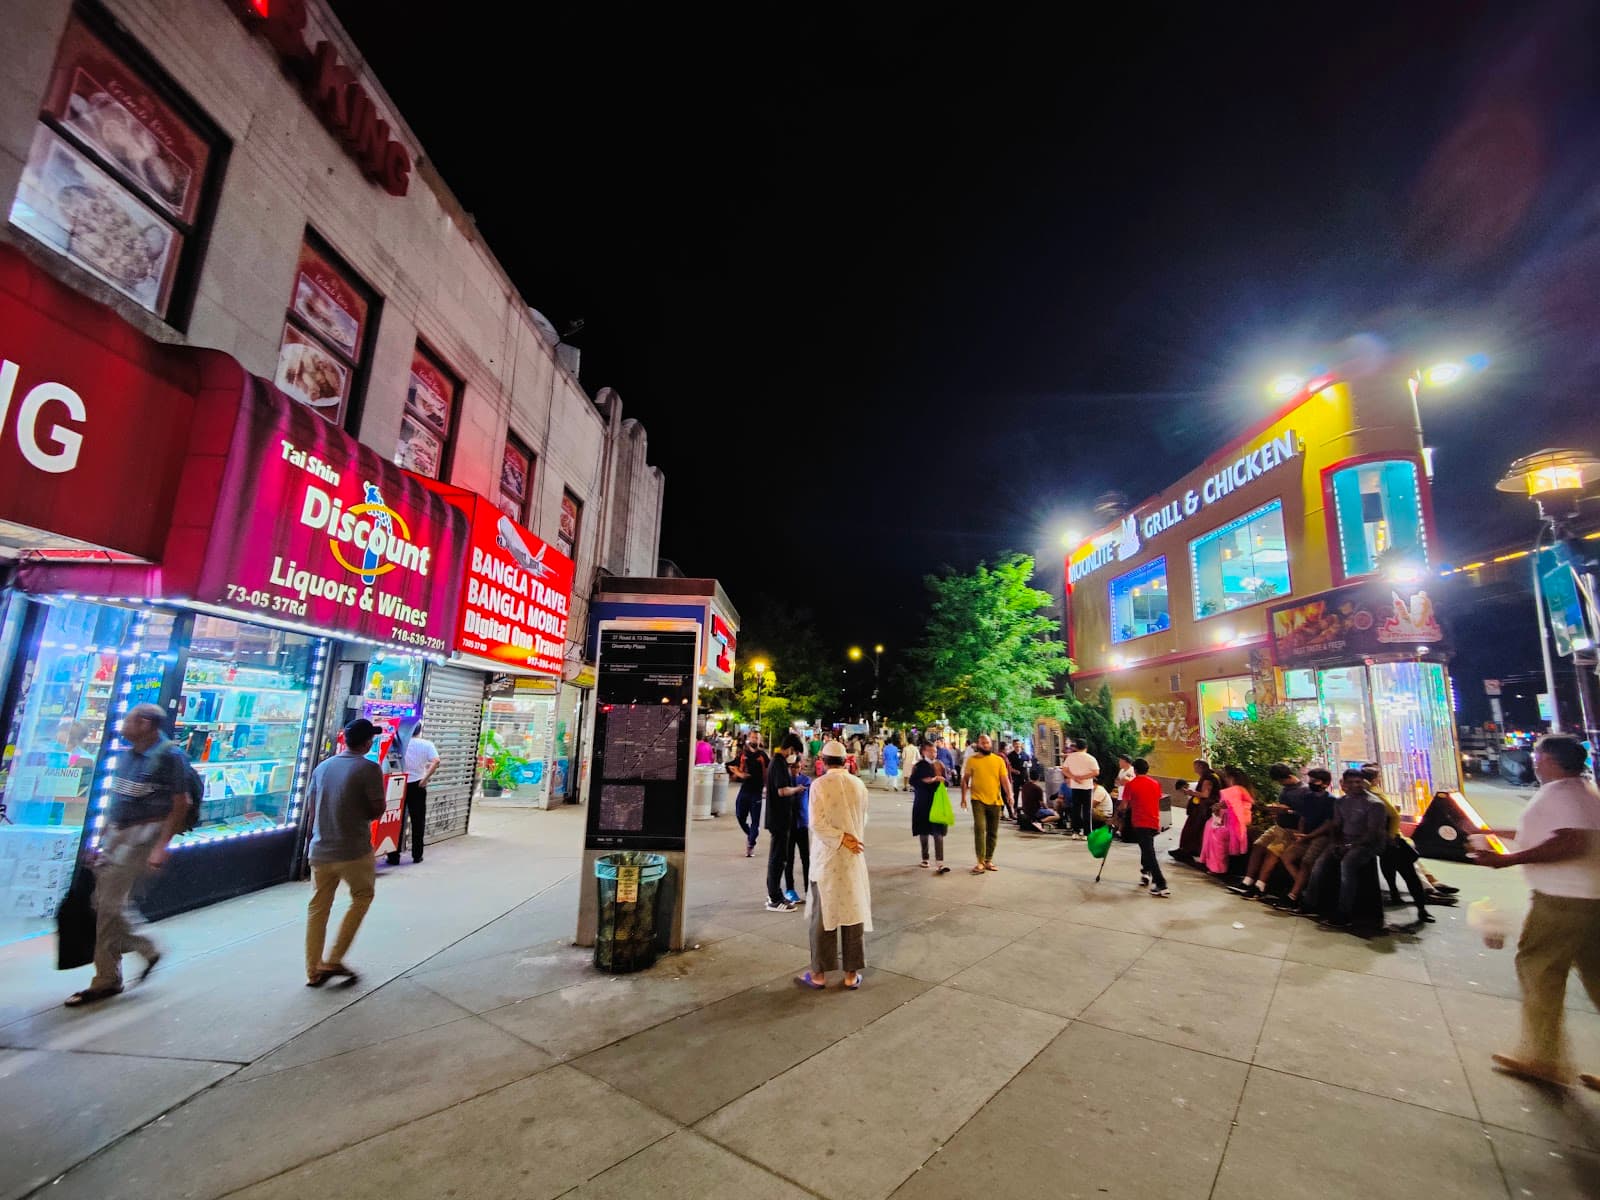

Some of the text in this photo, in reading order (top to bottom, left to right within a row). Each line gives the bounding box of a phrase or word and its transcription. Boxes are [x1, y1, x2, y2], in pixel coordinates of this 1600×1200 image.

[280, 439, 340, 487] Tai Shin
[300, 485, 431, 576] Discount
[1068, 428, 1300, 584] MOONLITE GRILL & CHICKEN
[227, 584, 308, 617] 73-05 37Rd
[269, 556, 428, 627] Liquors & Wines
[467, 577, 567, 639] BANGLA MOBILE
[471, 546, 568, 616] BANGLA TRAVEL
[464, 609, 563, 660] Digital One Travel
[380, 808, 401, 825] ATM
